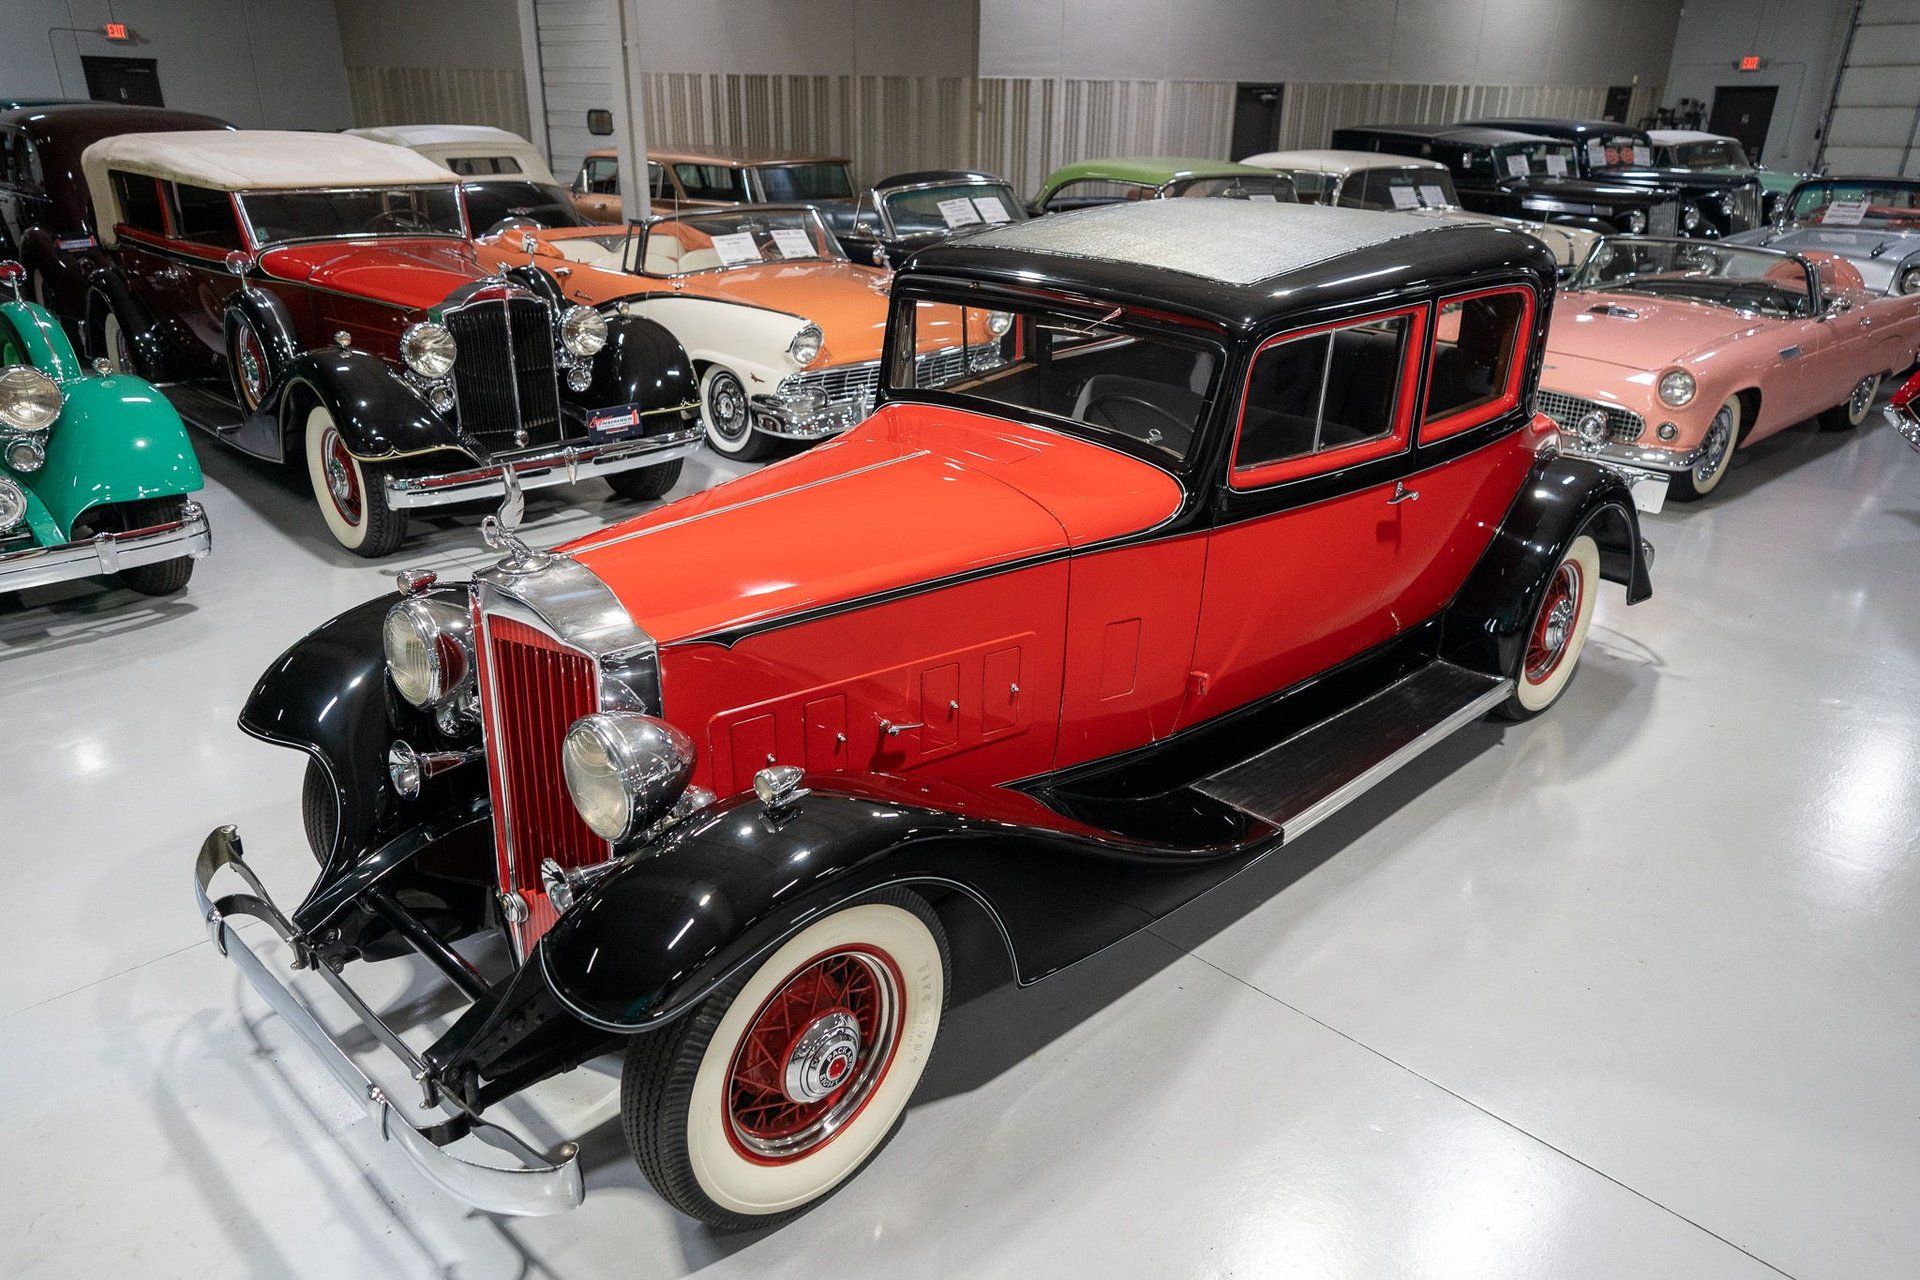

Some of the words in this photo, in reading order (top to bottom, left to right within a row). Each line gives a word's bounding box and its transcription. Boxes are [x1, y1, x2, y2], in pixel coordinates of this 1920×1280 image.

[107, 24, 126, 38] EXIT
[1742, 57, 1759, 70] EXIT
[827, 1046, 853, 1069] PACKARD
[819, 1073, 840, 1088] EIGHT
